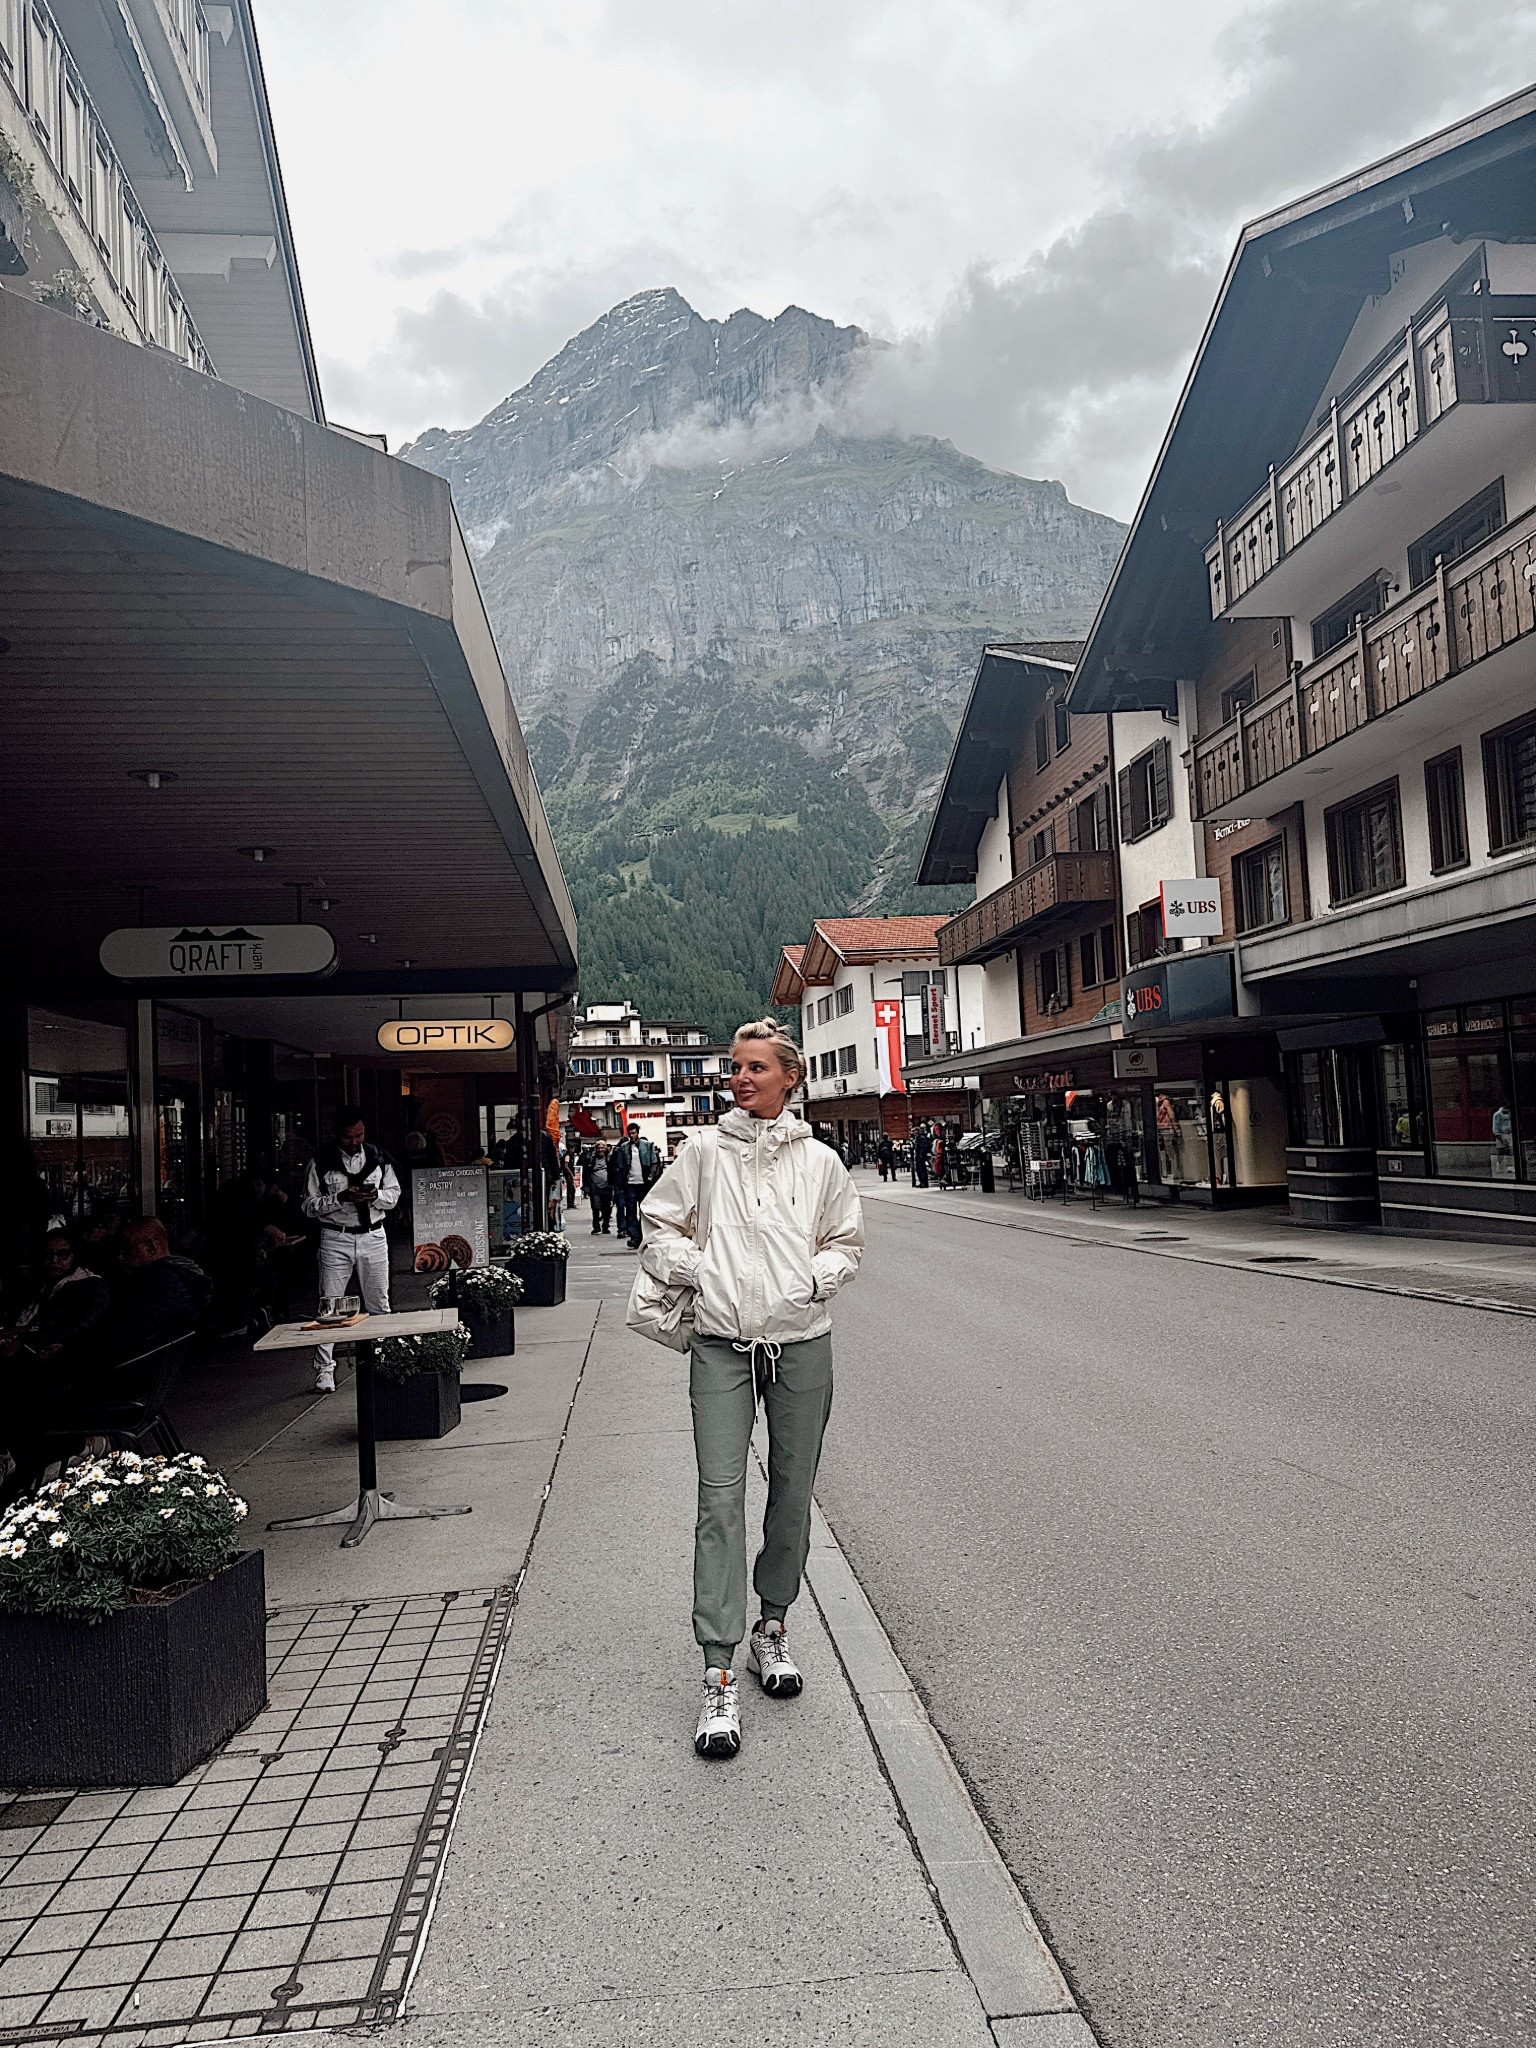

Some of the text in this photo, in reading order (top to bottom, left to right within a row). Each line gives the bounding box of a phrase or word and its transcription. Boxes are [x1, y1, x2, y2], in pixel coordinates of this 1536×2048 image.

[1186, 900, 1216, 914] UBS
[169, 943, 246, 974] QRAFT
[249, 943, 263, 970] werk
[930, 988, 938, 1012] Sport
[1135, 984, 1162, 1013] UBS
[396, 1025, 497, 1046] OPTIK
[418, 1178, 426, 1204] BRUNCH
[430, 1182, 454, 1190] PASTRY
[475, 1220, 486, 1264] CROISSANT
